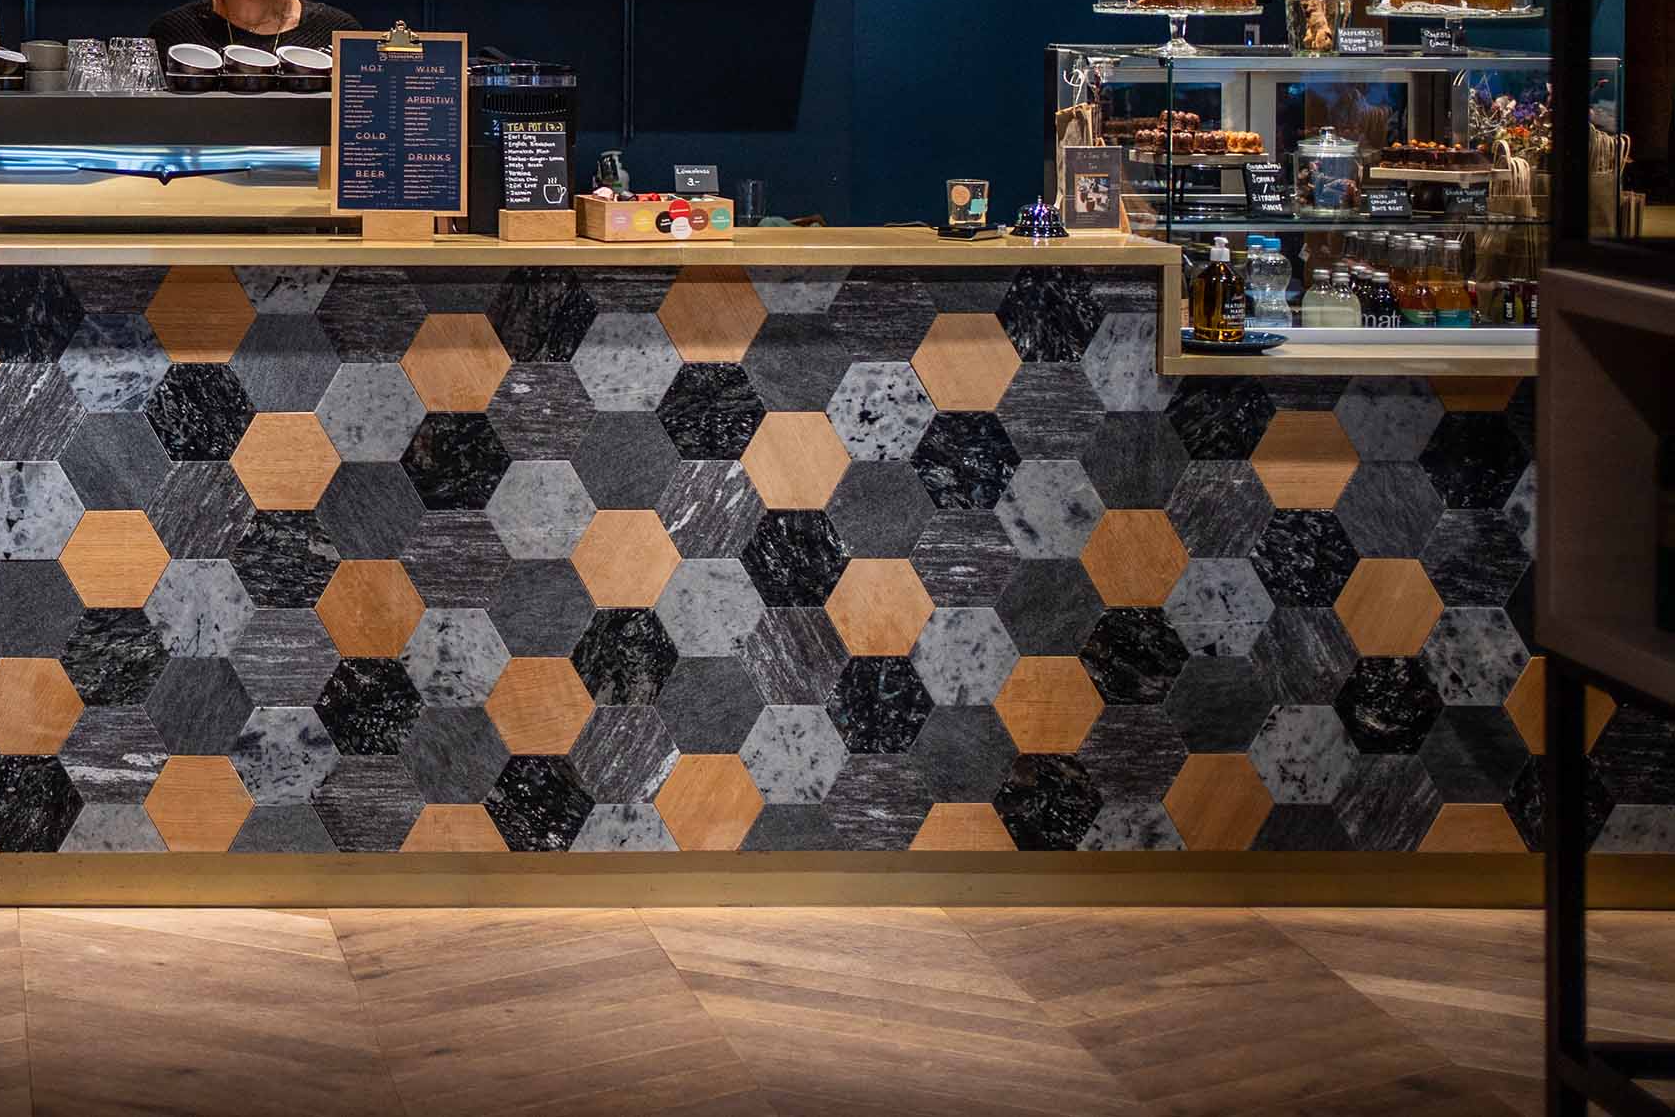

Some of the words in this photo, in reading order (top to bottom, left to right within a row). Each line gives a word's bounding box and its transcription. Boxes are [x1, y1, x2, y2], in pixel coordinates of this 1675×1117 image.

[361, 64, 383, 72] HOT
[416, 66, 445, 74] WINE
[407, 96, 454, 104] APERITIVI
[508, 123, 524, 131] TEA
[529, 123, 542, 131] POT
